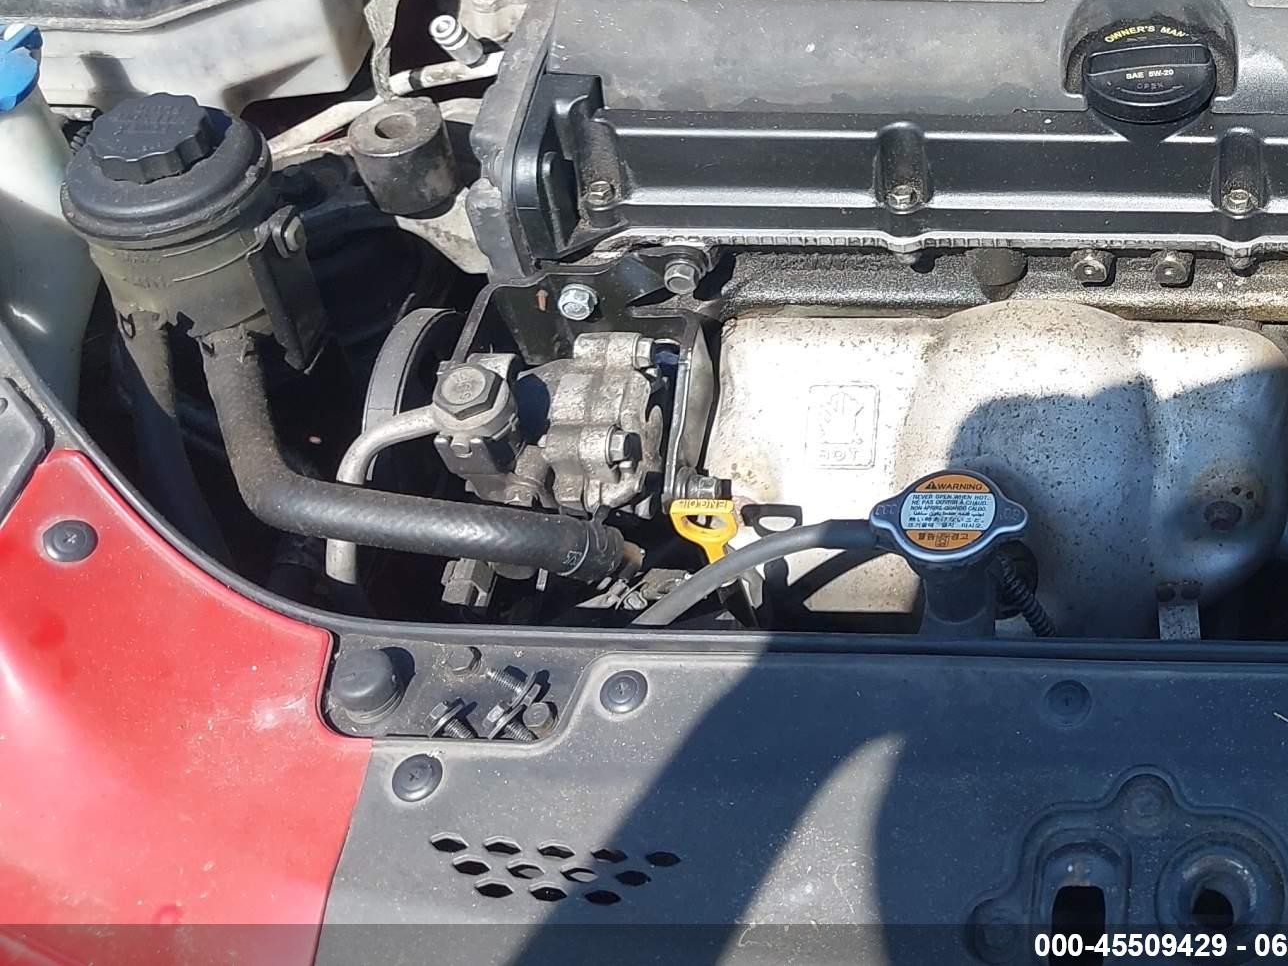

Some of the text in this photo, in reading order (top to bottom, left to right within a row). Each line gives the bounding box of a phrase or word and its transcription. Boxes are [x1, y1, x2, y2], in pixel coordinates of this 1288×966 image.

[1104, 25, 1156, 43] OWNER'S
[1126, 69, 1174, 80] SAE 5W-20
[937, 483, 983, 491] WARNING
